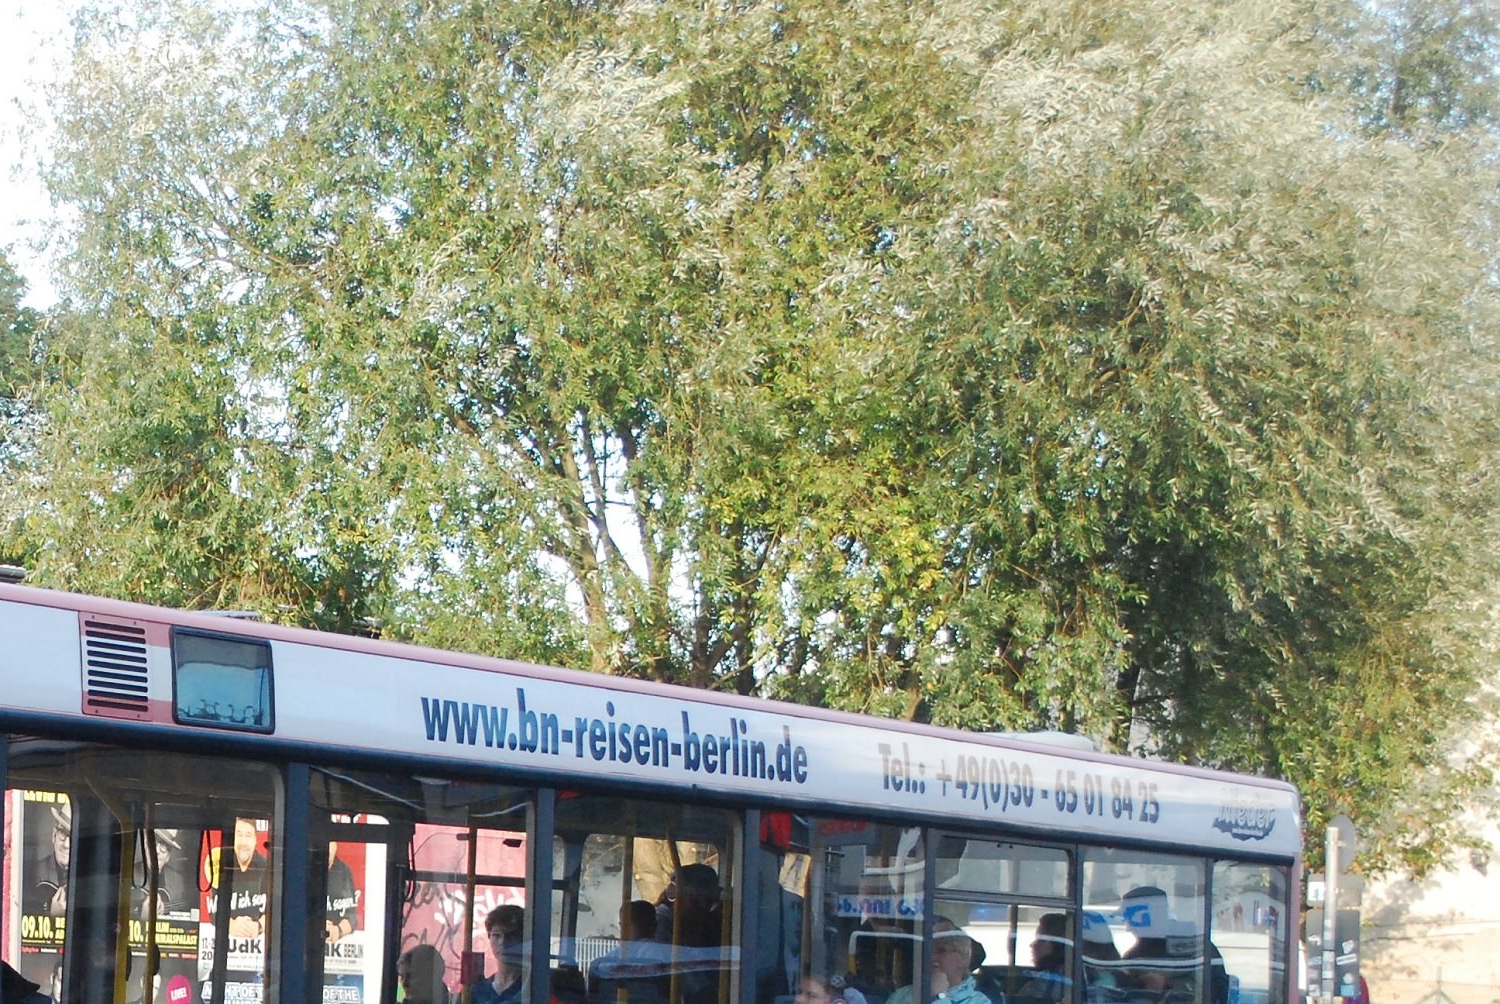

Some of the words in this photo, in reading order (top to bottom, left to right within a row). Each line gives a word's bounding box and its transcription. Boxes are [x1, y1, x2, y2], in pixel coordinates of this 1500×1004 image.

[420, 687, 809, 784] www.bn-reisen-berlin.de
[878, 742, 926, 794] Tel.:
[1055, 768, 1078, 813] 65
[1083, 773, 1103, 817] 01
[1111, 777, 1133, 821] 84
[1138, 780, 1160, 824] 25
[21, 915, 54, 939] 09.10.
